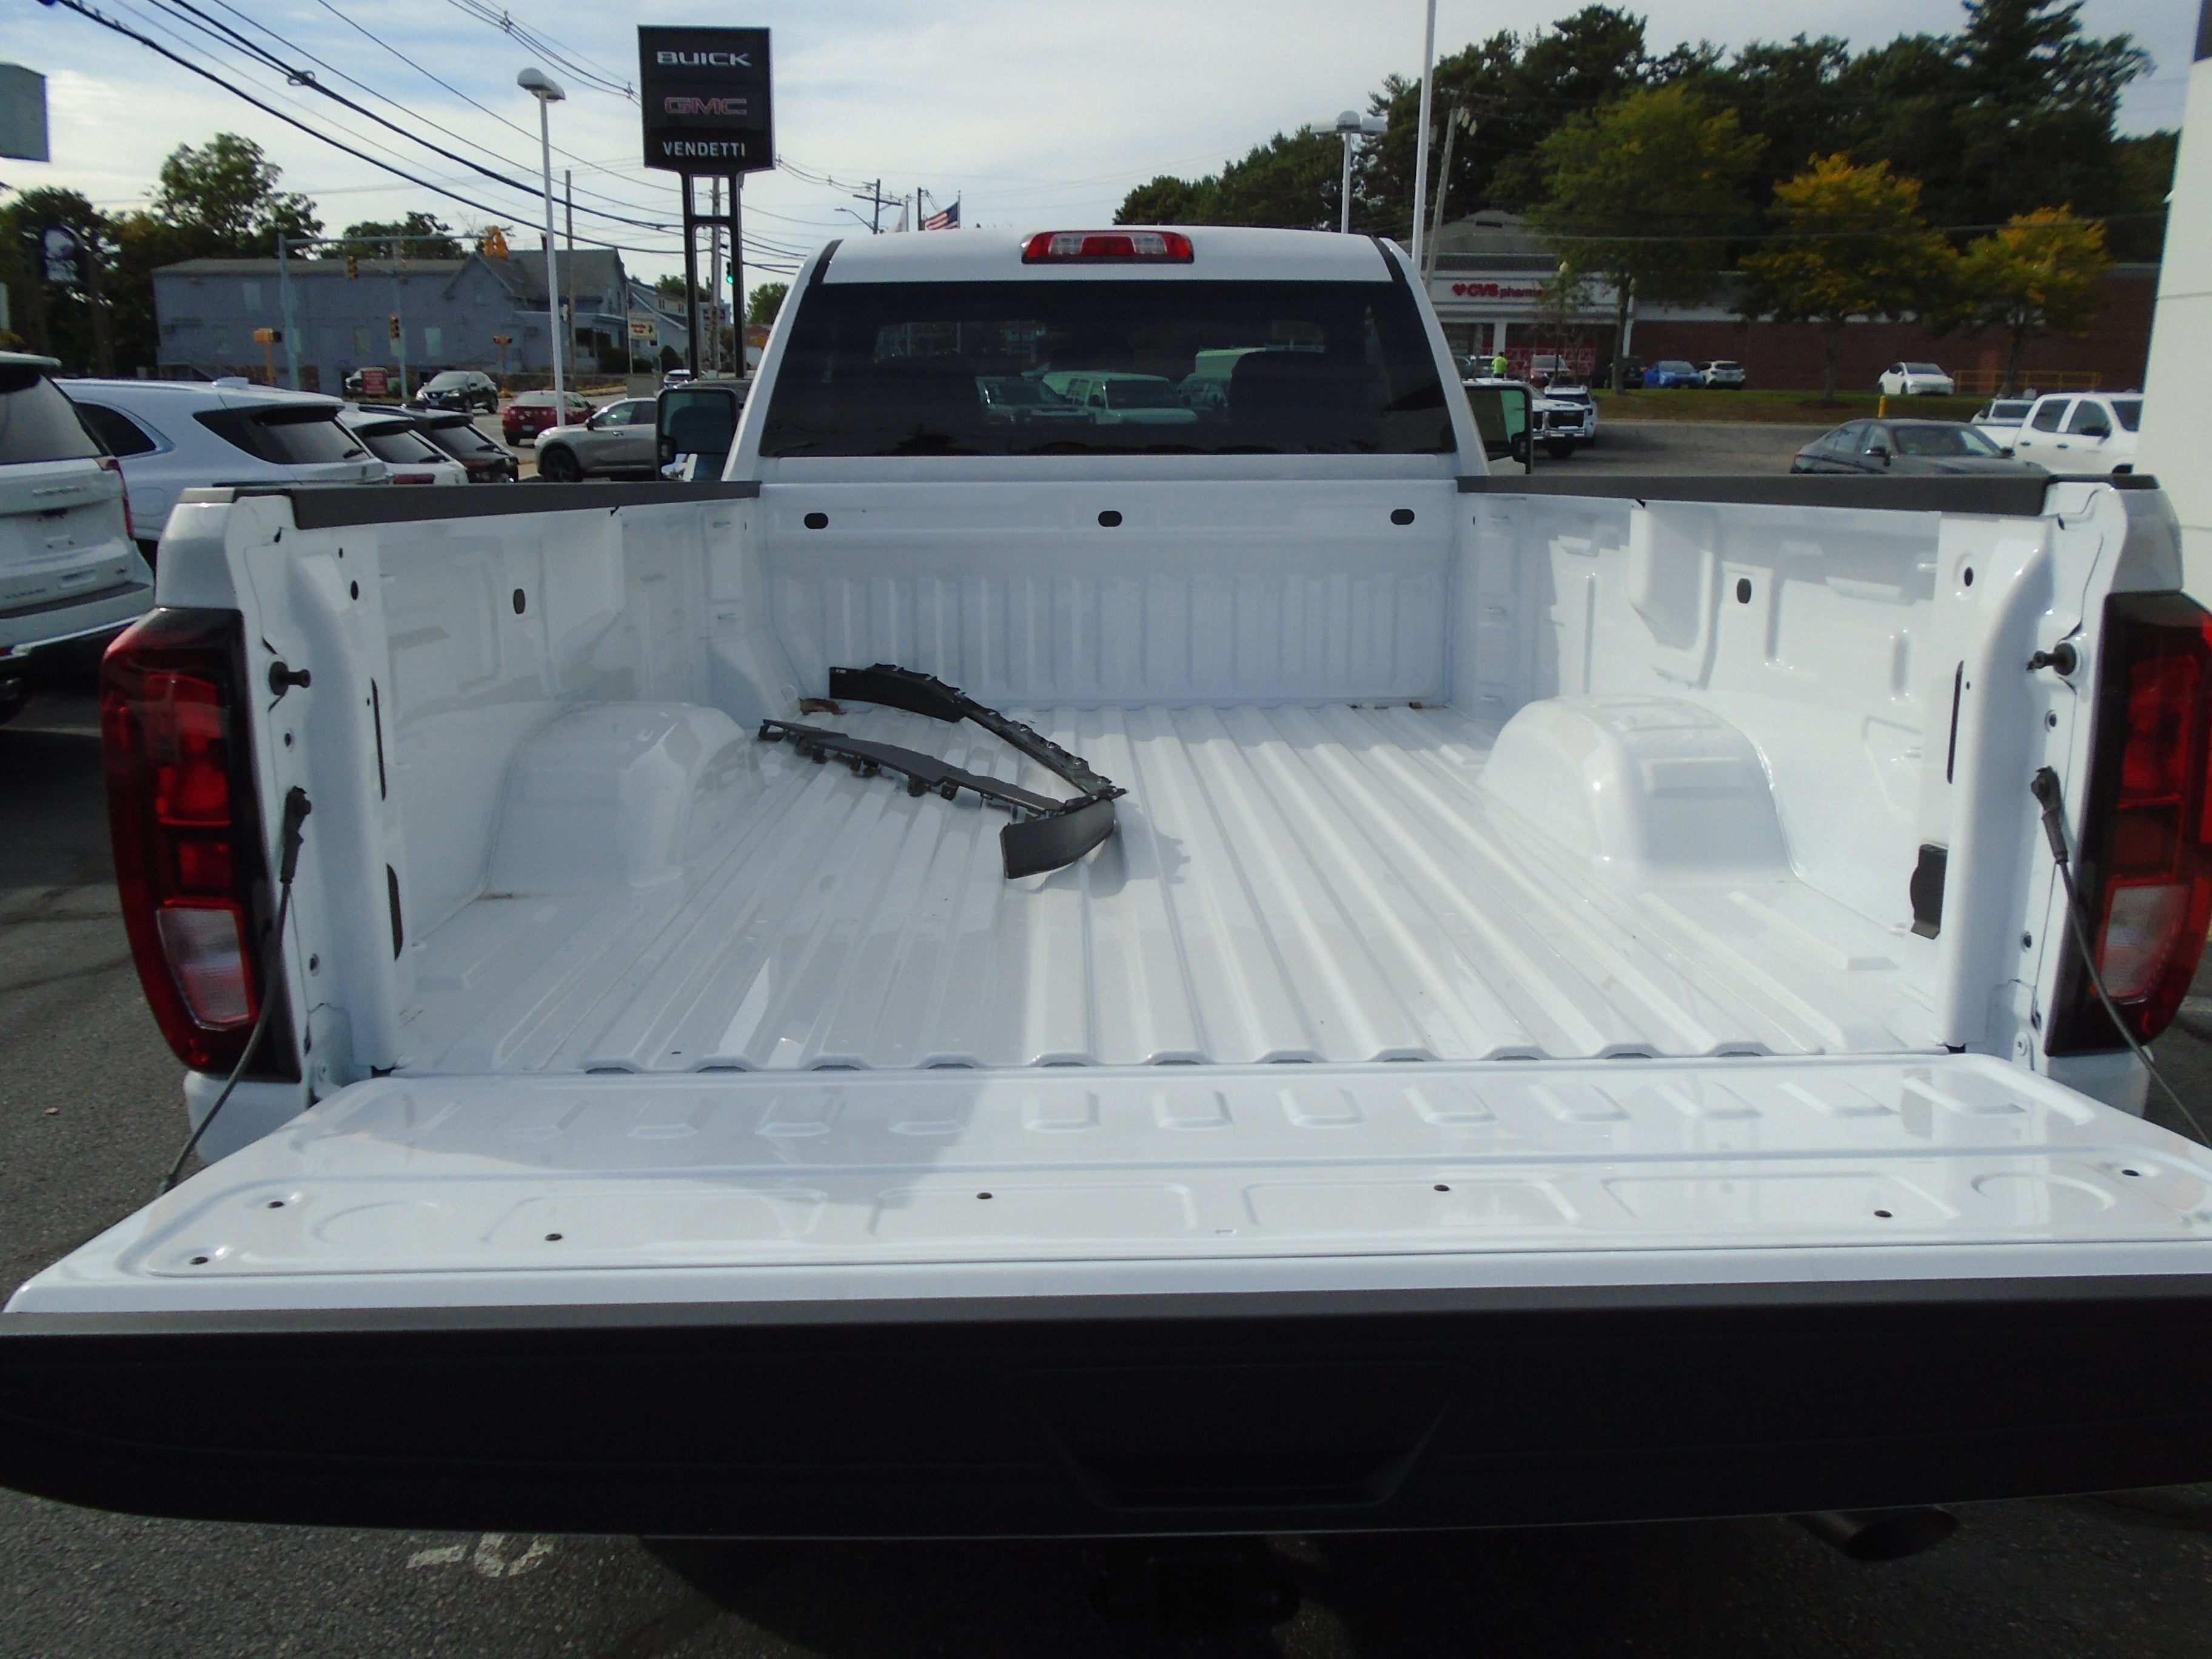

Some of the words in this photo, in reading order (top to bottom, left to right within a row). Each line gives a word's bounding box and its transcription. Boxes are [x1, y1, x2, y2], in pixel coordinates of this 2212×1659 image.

[657, 51, 752, 67] BUICK
[665, 96, 748, 115] GMC
[662, 141, 746, 157] VENDETTI
[1467, 283, 1498, 297] CVS
